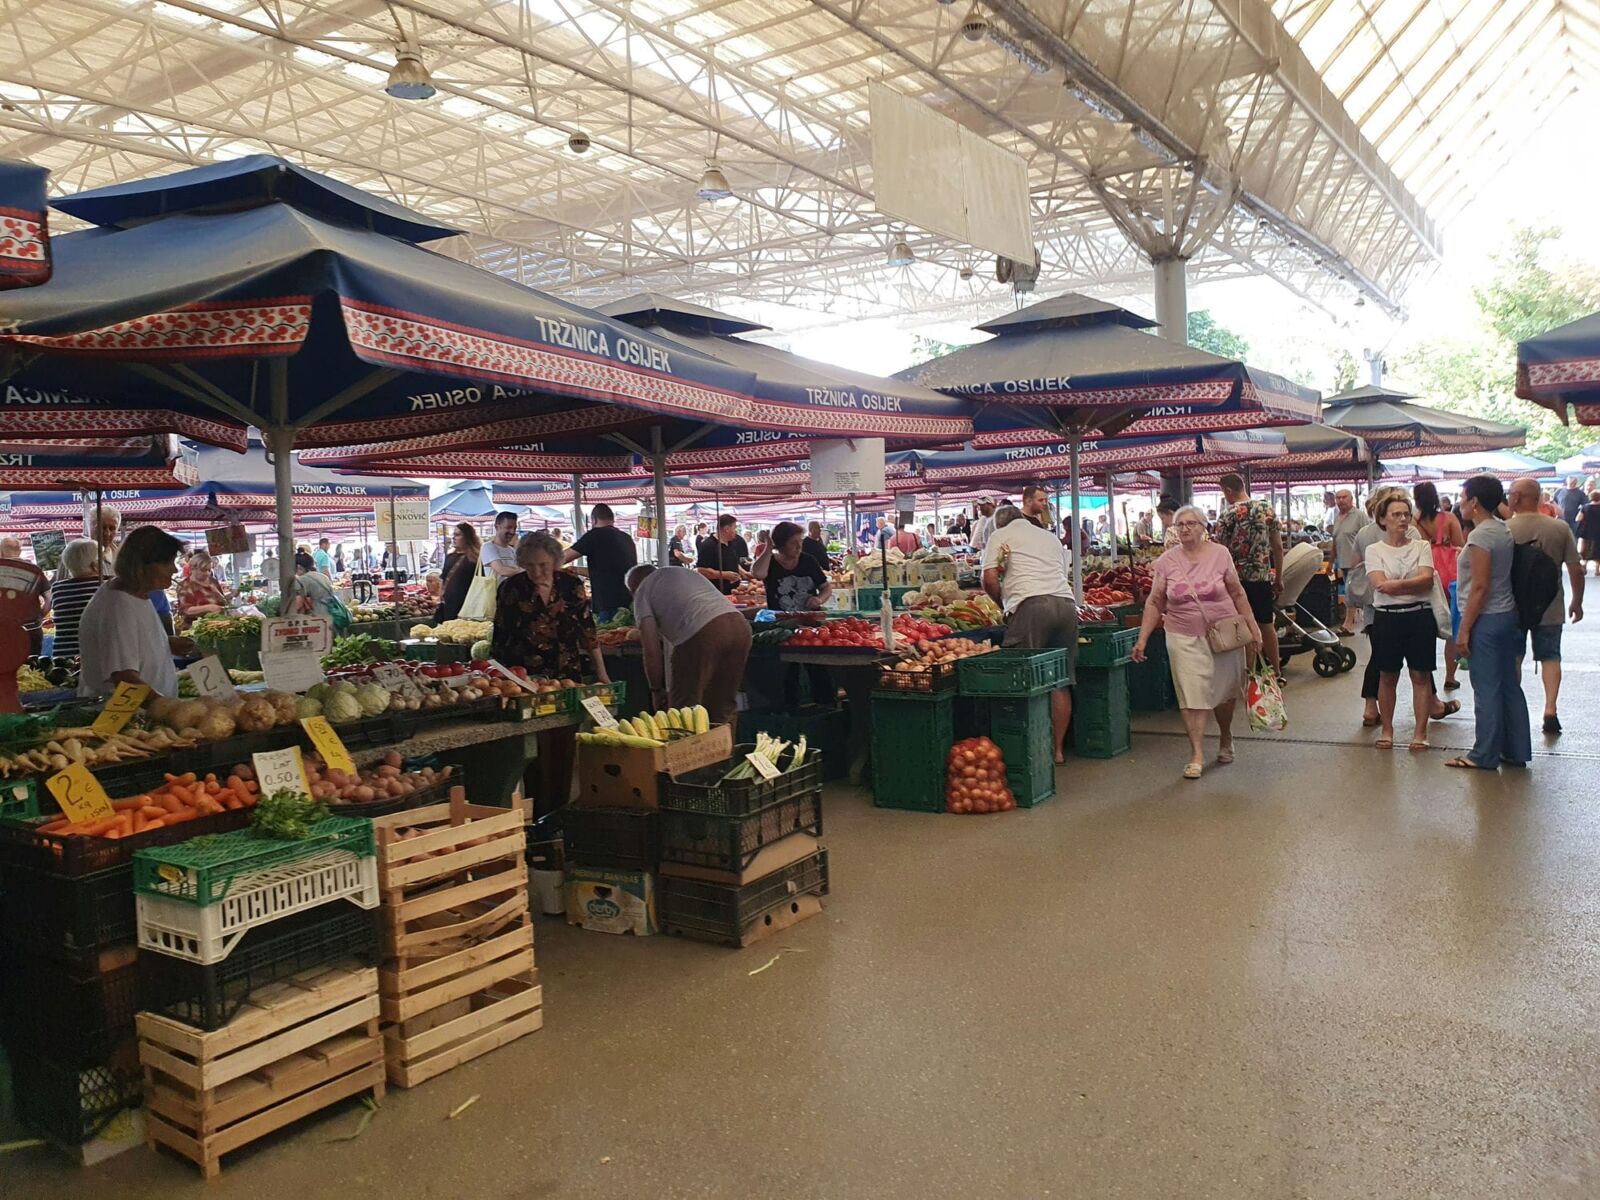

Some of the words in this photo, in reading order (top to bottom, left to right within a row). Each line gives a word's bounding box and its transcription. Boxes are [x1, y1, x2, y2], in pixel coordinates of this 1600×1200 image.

[534, 315, 610, 357] TRŽNICA
[616, 338, 672, 373] OSIJEK
[1004, 376, 1072, 393] OSIJEK
[805, 387, 857, 408] TRŽNICA
[862, 394, 902, 412] OSIJEK
[1005, 445, 1052, 460] TRŽNICA
[1057, 440, 1099, 454] OSJEK
[72, 490, 107, 501] TRNIA
[110, 489, 141, 499] OSIJEK
[293, 485, 332, 495] TRŽNICA
[335, 486, 367, 495] OSIJEK
[199, 665, 217, 691] 2
[57, 774, 83, 806] 2
